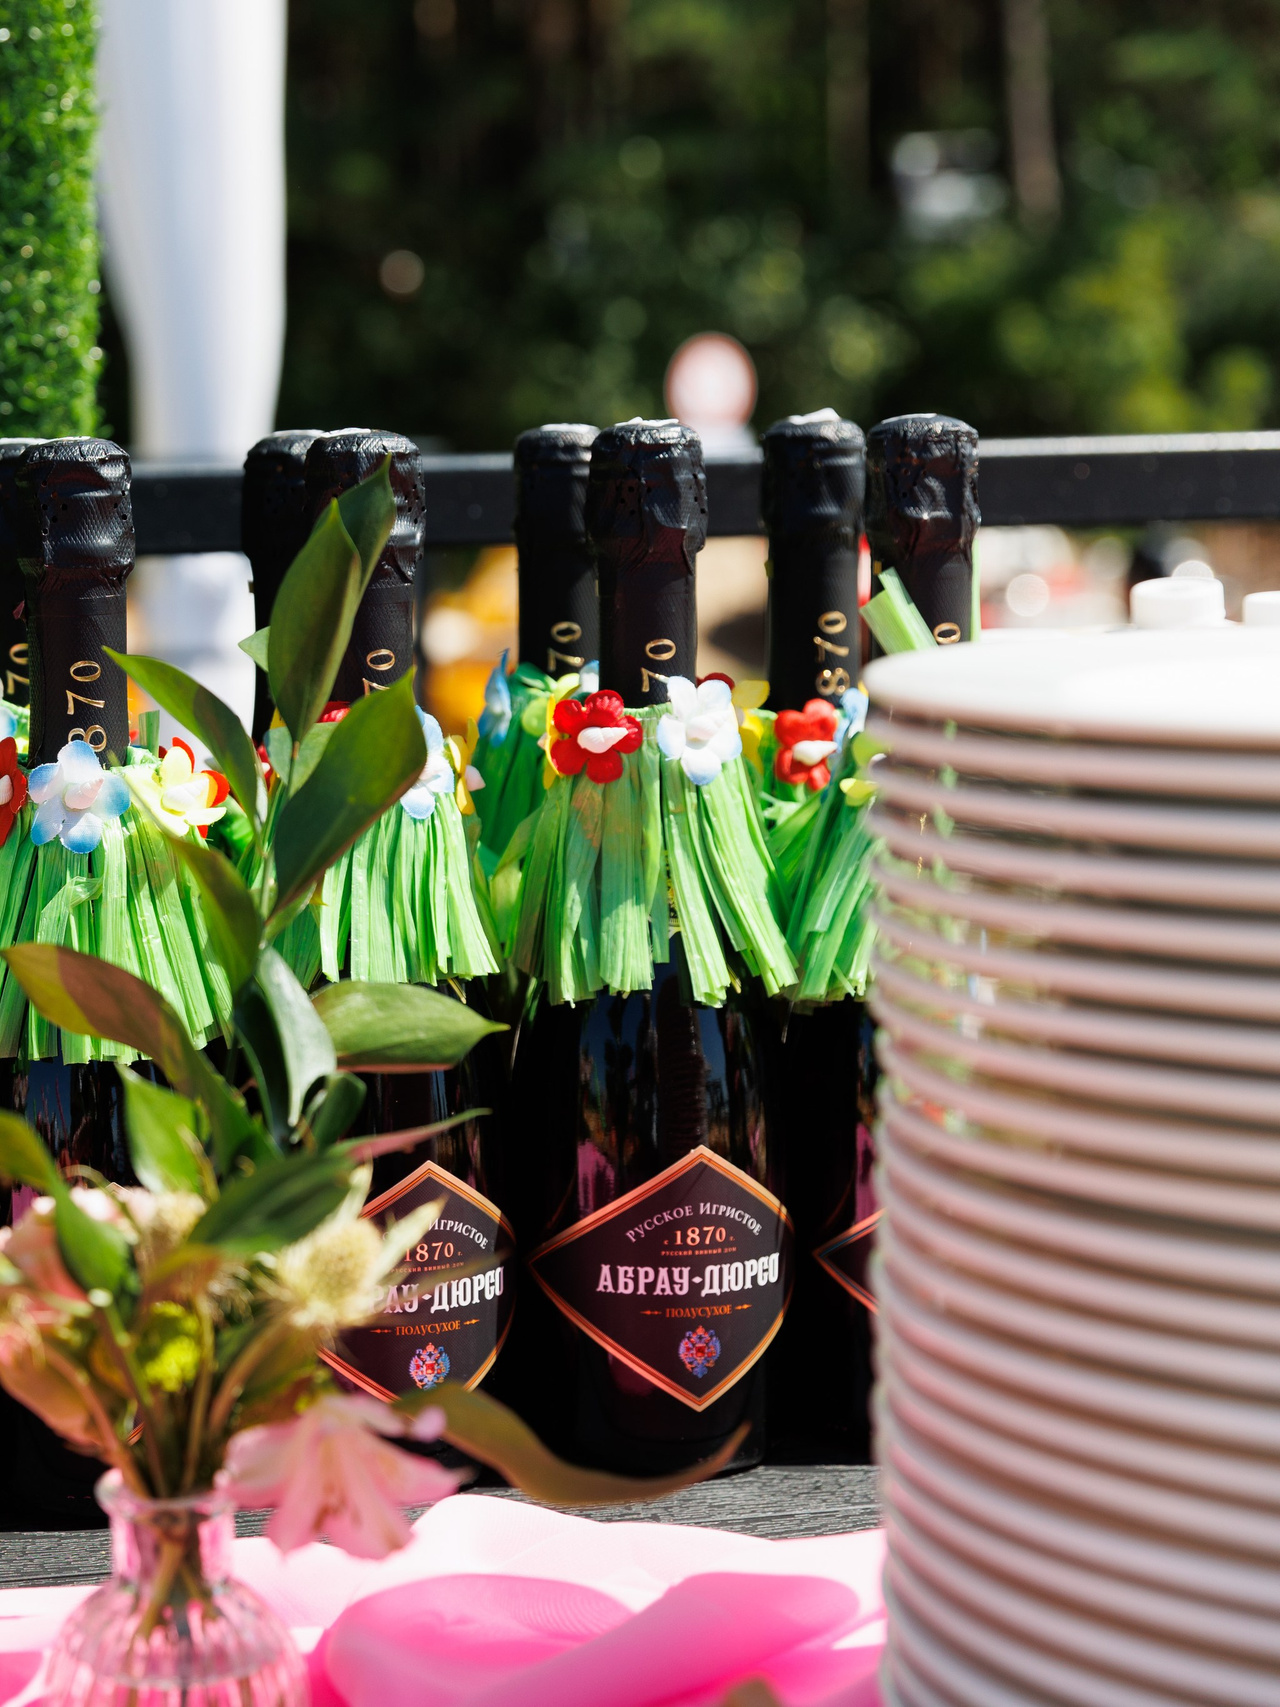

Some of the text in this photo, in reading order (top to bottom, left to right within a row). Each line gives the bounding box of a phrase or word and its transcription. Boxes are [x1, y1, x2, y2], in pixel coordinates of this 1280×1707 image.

[66, 660, 107, 753] 870
[674, 1226, 727, 1246] 1870
[404, 1241, 455, 1262] 1870
[596, 1252, 780, 1297] АБРАУ-ДЮРСО
[665, 1303, 733, 1319] ПОЛУСУХОЕ
[395, 1320, 461, 1337] ПОЛУСУХОЕ
